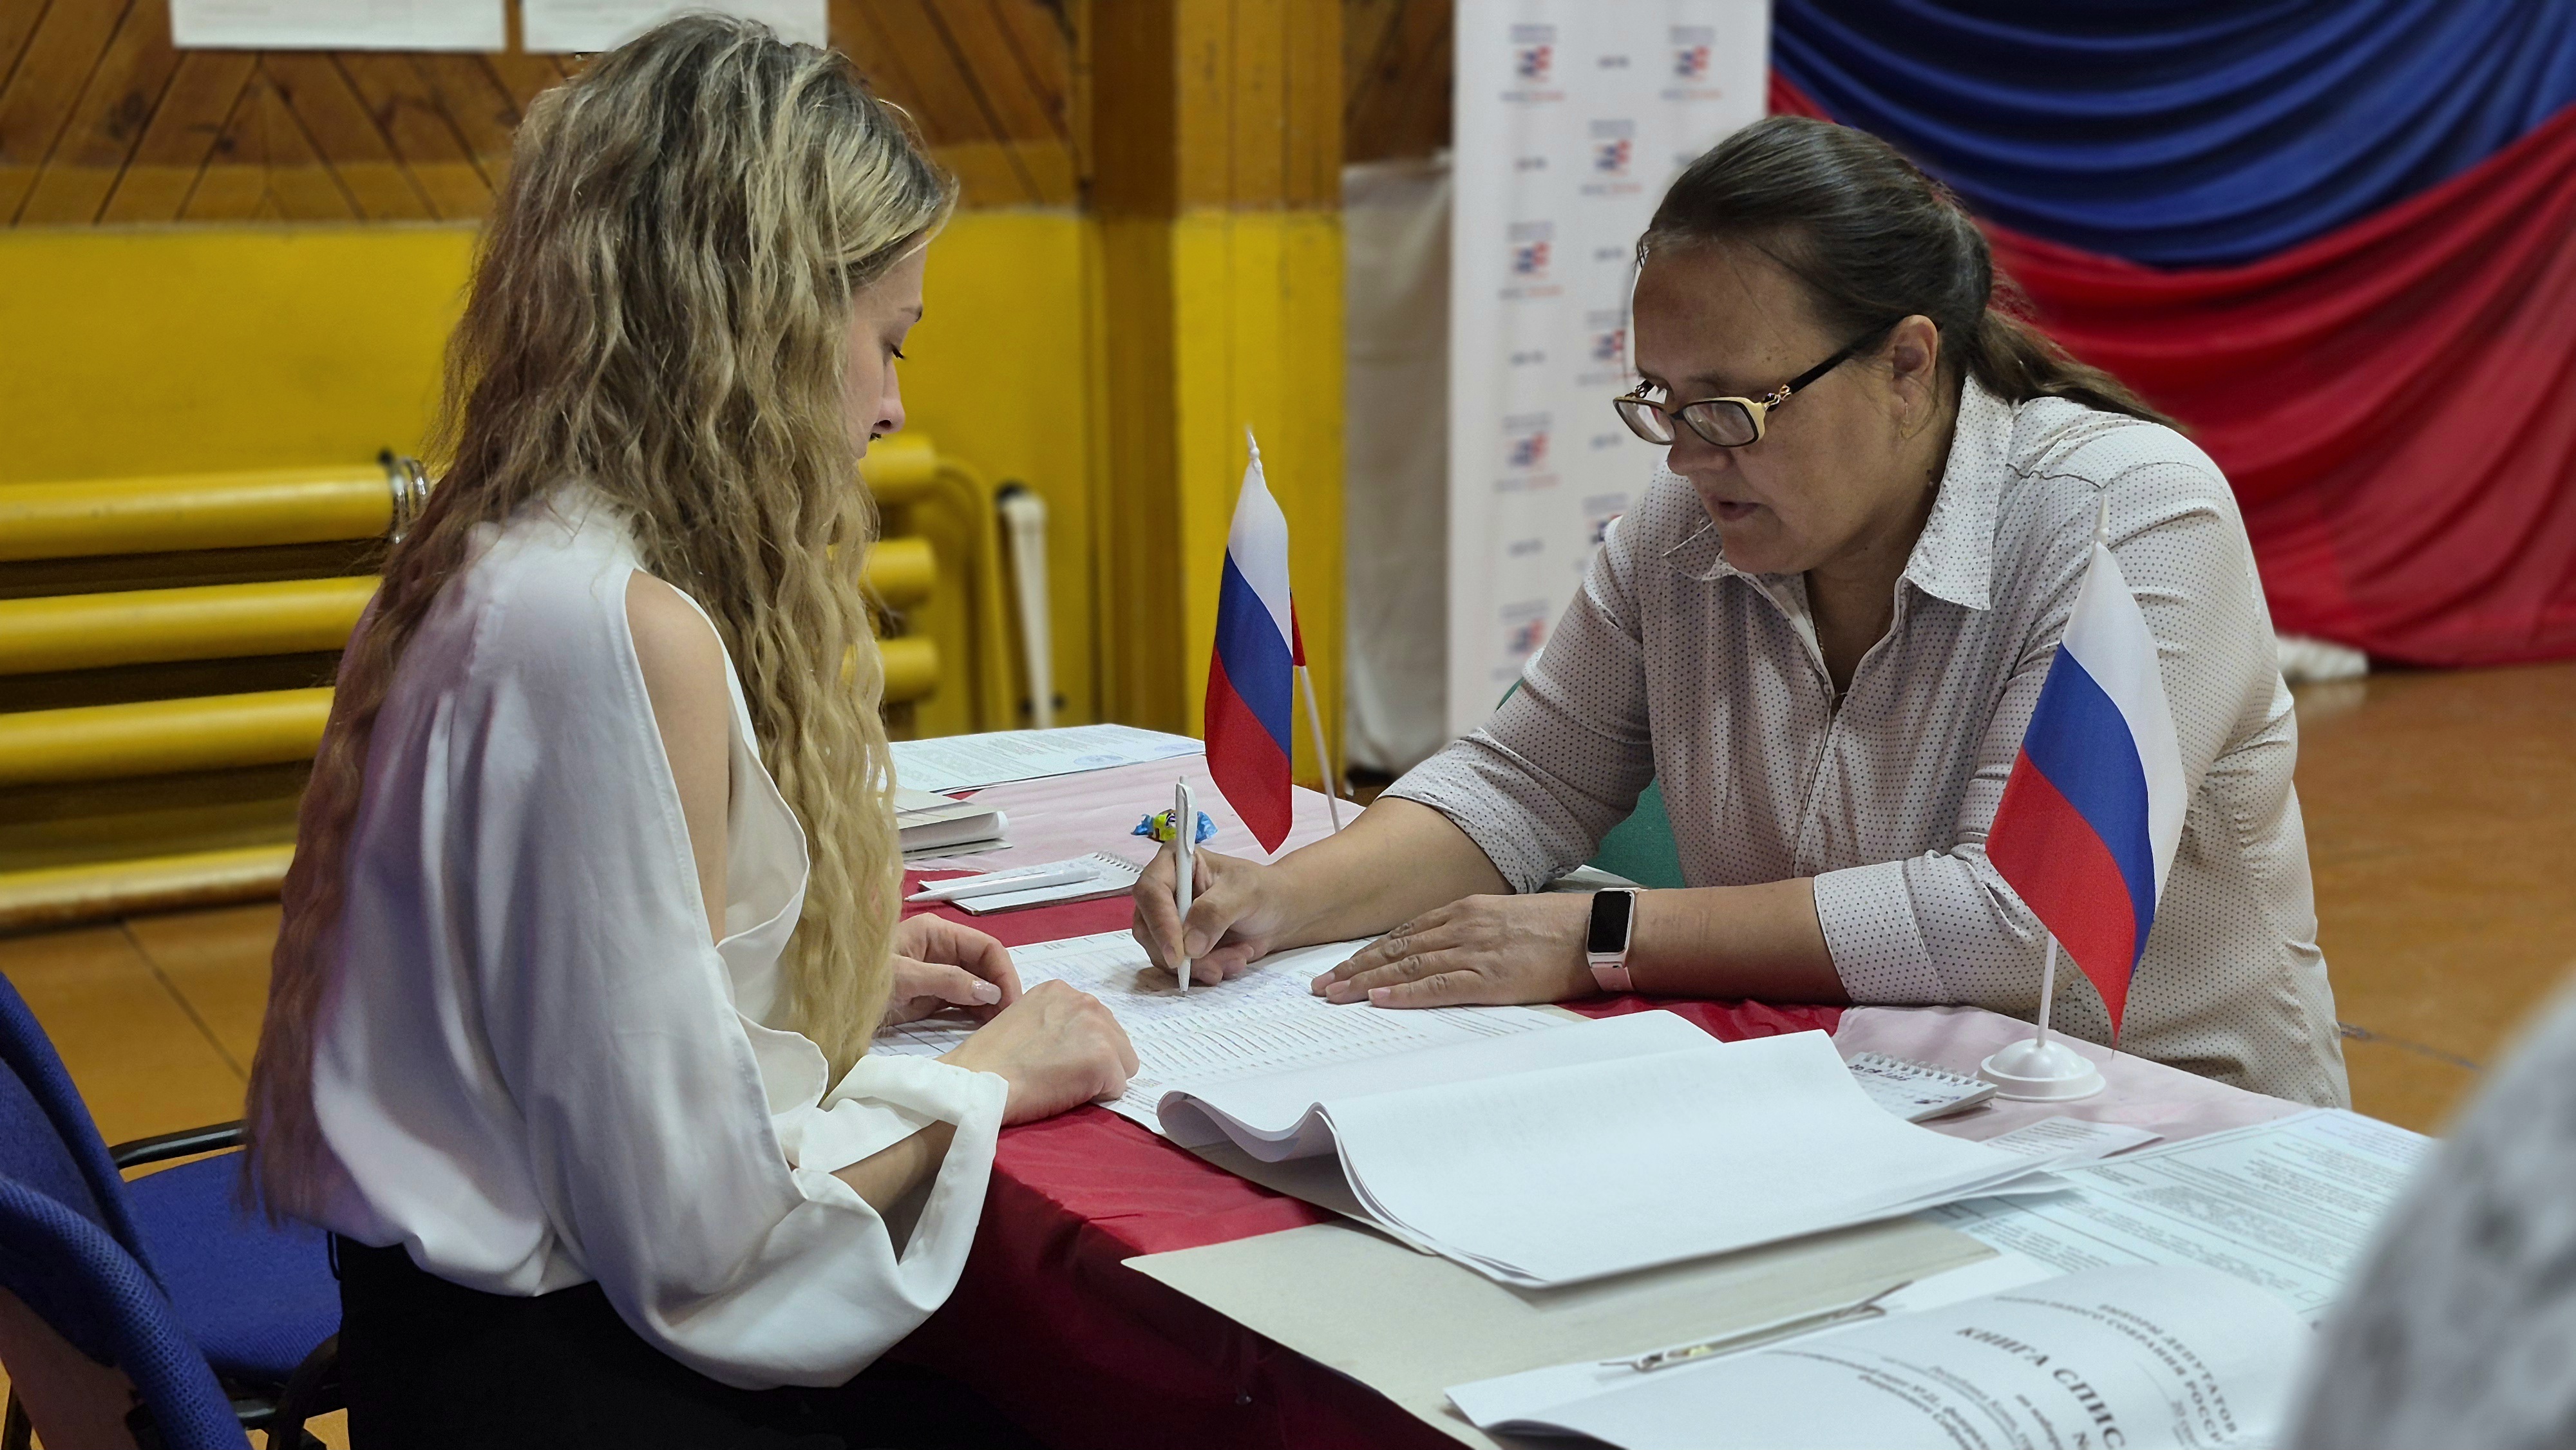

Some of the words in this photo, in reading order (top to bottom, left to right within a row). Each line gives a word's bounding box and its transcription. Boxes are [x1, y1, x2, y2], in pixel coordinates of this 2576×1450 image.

[1956, 1326, 2050, 1368] КНИГА
[2106, 1317, 2187, 1378] СОБРАНИЯ
[2184, 1379, 2224, 1444] РОССИ
[2161, 1335, 2238, 1435] ДЕПУТАТОВ
